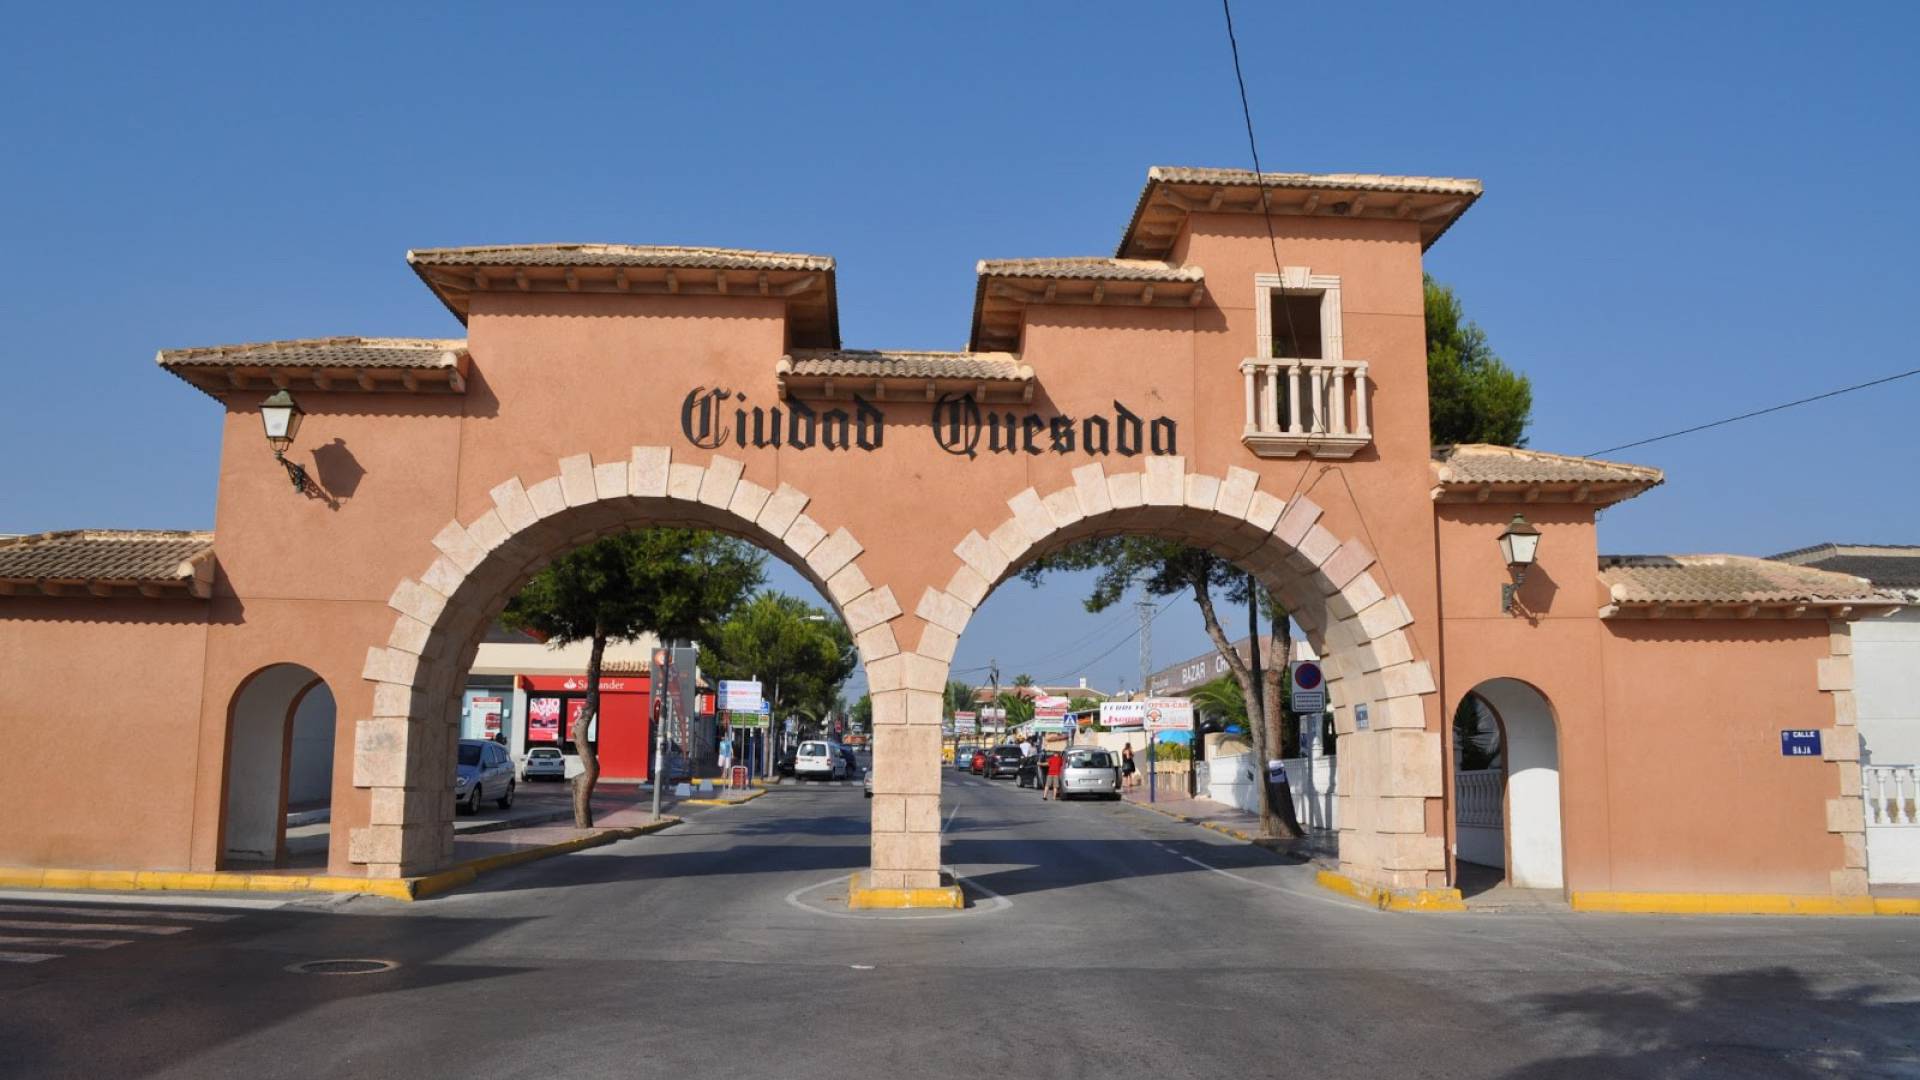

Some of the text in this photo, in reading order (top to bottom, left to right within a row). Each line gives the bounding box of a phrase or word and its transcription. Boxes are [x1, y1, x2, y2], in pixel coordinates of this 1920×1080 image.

[680, 384, 1178, 461] Ciudad Quesada
[1181, 662, 1206, 685] BAZAR
[577, 679, 625, 690] Saander
[1792, 746, 1811, 755] BAJA
